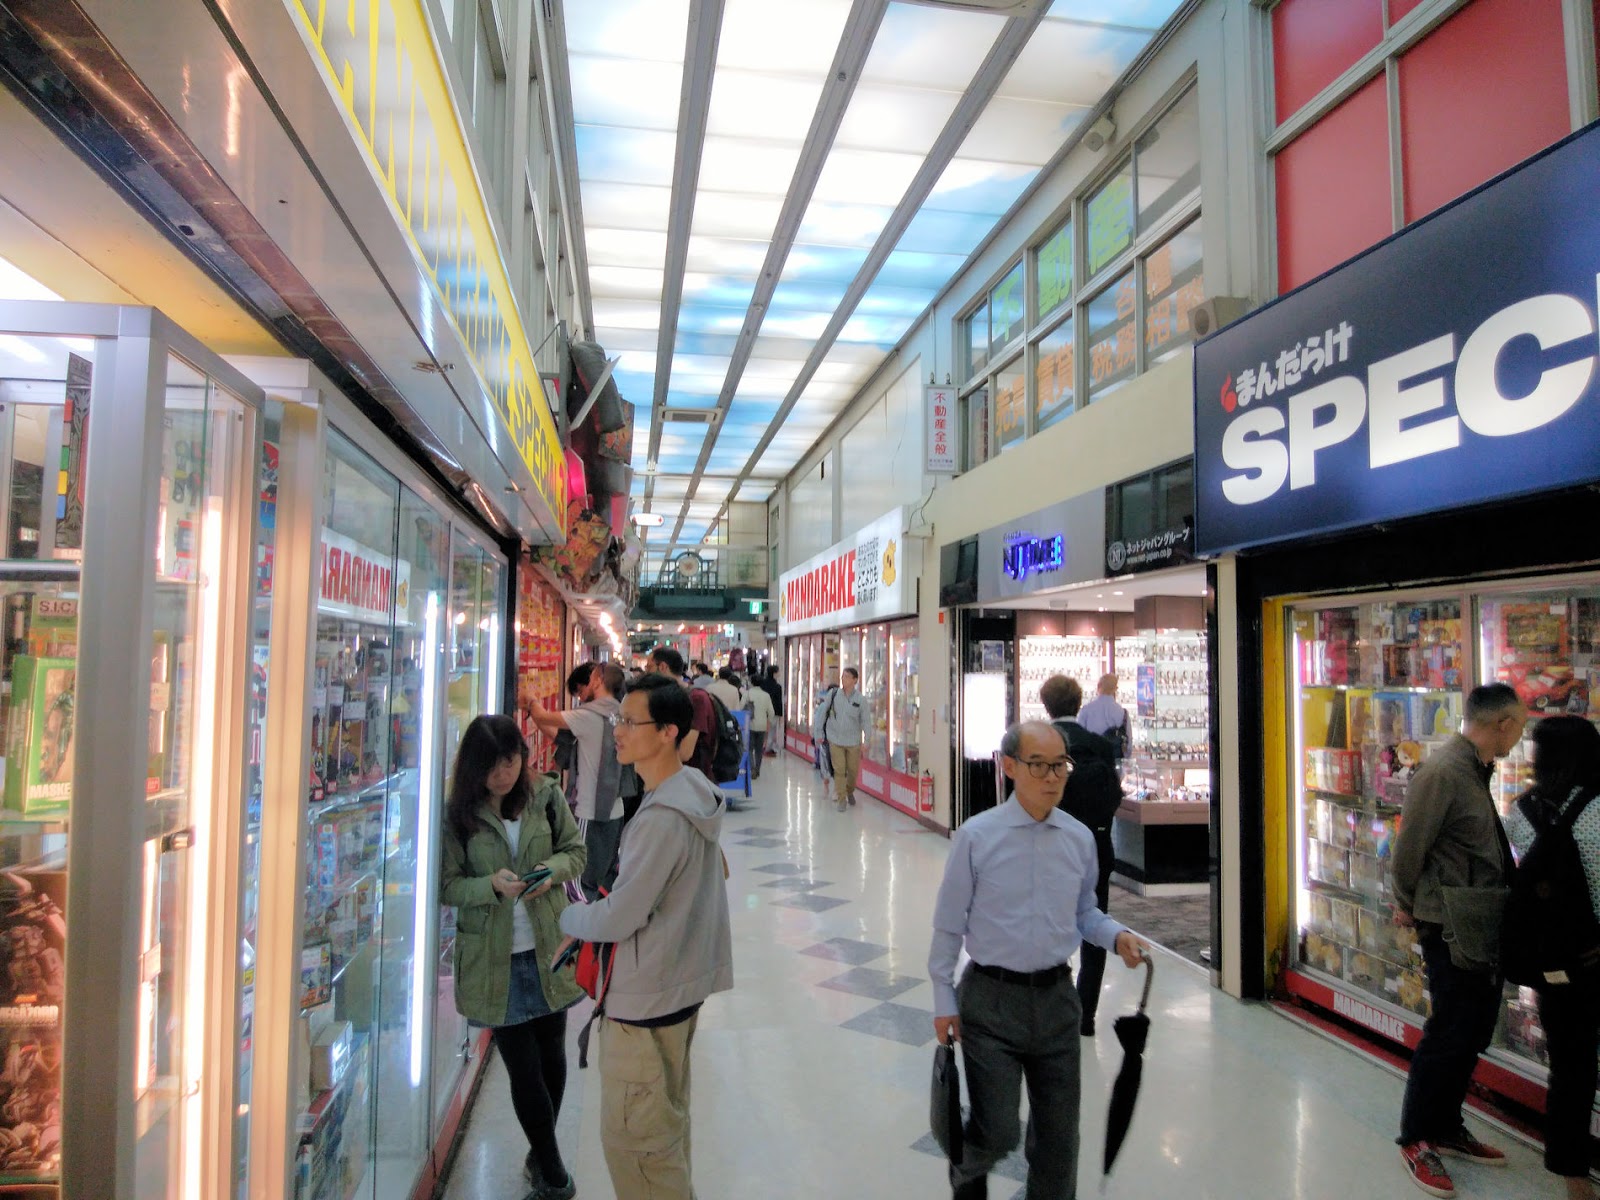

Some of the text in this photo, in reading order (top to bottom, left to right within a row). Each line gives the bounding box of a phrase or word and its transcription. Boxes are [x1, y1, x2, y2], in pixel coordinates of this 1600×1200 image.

[298, 0, 512, 425] ANDARAKE
[513, 357, 559, 517] SPECIAL
[1221, 272, 1600, 506] SPEC
[1235, 320, 1353, 407] まんだらけ
[934, 392, 947, 456] 不動産全般
[1126, 527, 1190, 555] ネットジャパングループ
[787, 549, 857, 623] MANDARAKE
[857, 564, 879, 589] どこよりも
[1333, 991, 1405, 1043] MANDARAKE
